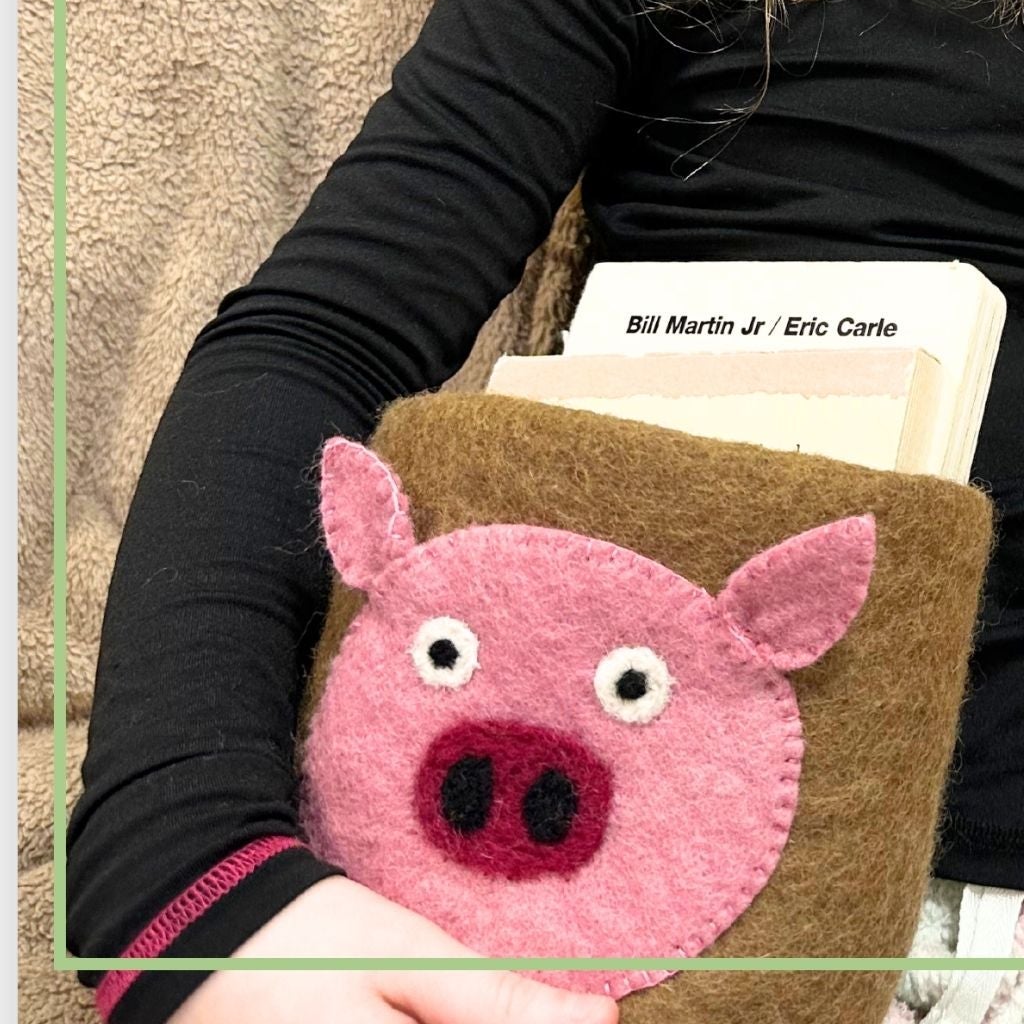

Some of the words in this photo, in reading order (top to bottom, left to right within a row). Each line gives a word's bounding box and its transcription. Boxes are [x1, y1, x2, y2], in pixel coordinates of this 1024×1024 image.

[626, 315, 662, 334] Bill
[665, 315, 735, 335] Martin
[741, 316, 766, 336] Jr
[768, 316, 782, 336] /
[783, 316, 829, 337] Eric
[837, 317, 898, 337] Carle
